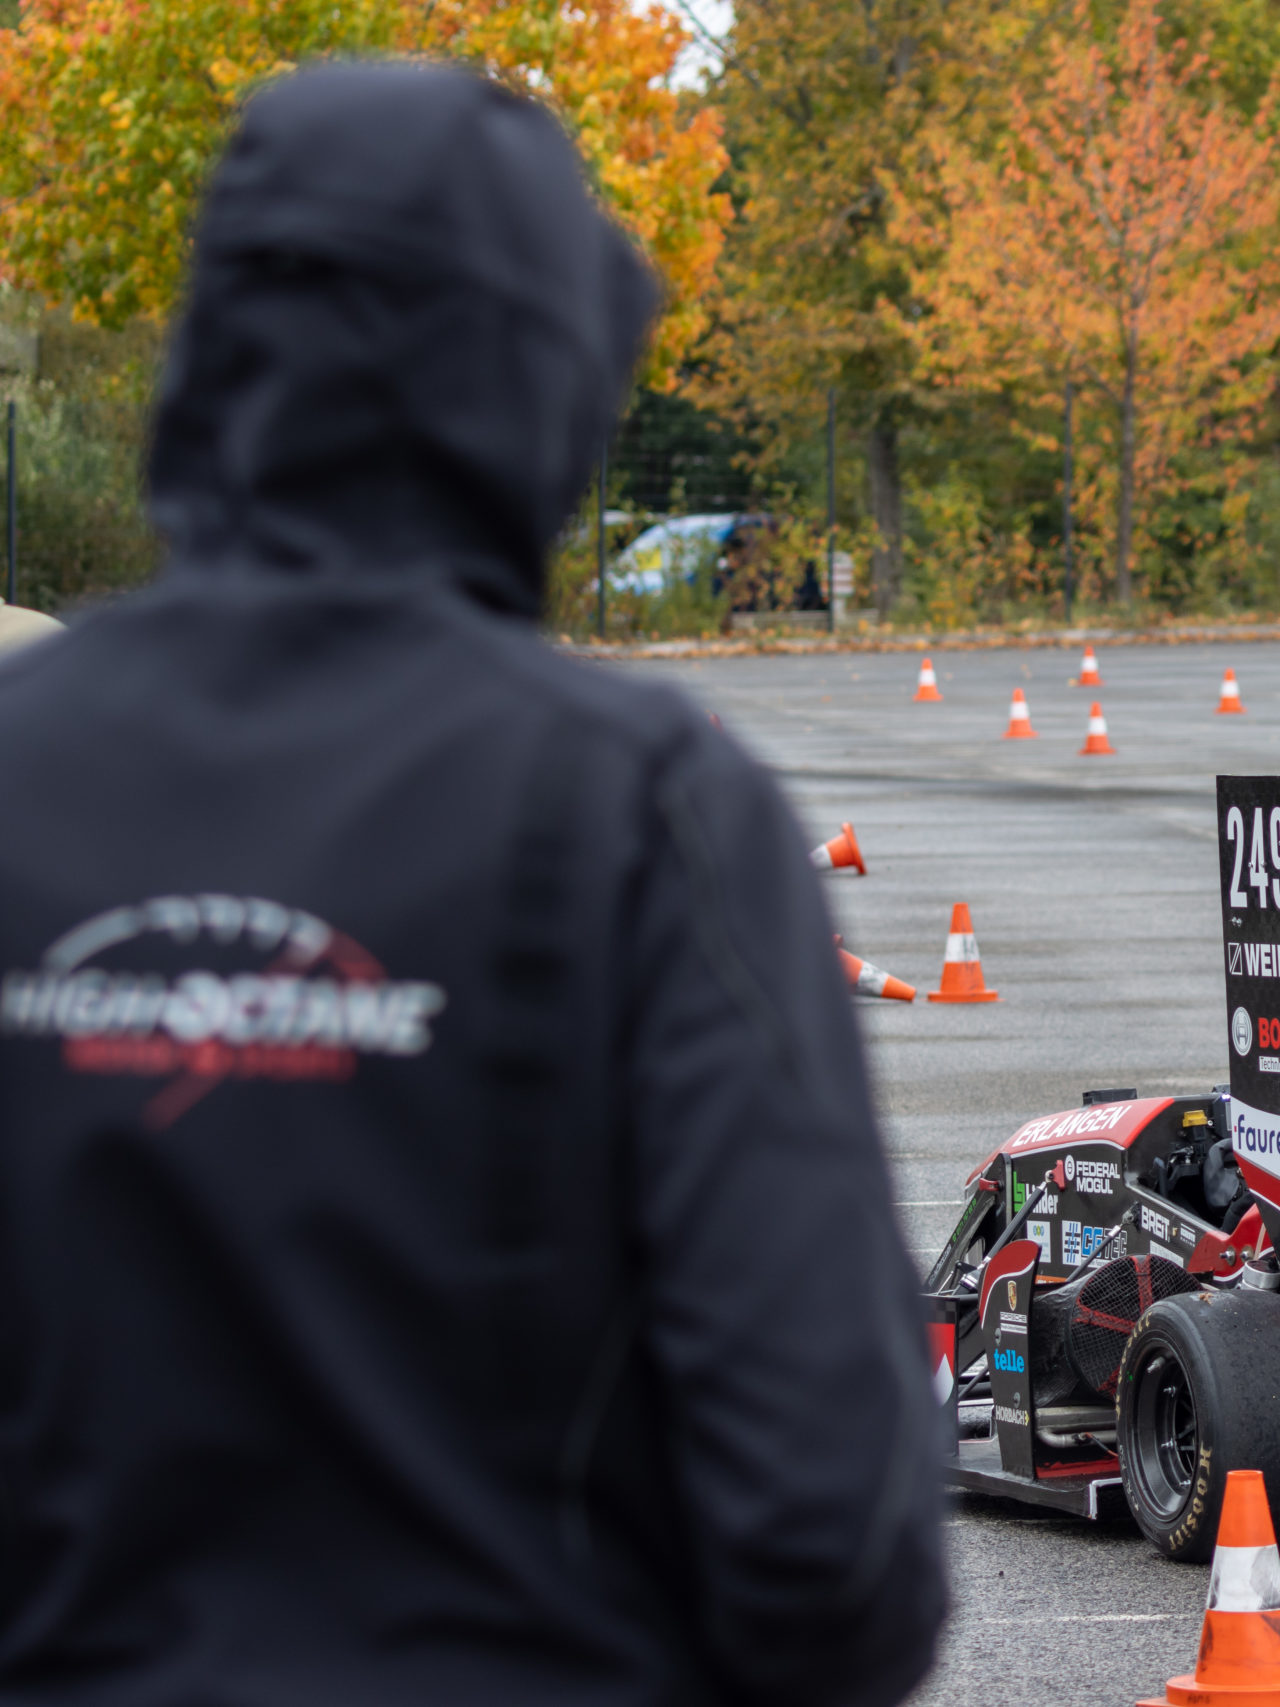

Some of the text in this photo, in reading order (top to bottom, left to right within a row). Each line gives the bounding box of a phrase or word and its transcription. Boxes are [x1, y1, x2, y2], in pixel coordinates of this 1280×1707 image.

[1012, 1105, 1132, 1147] ERLANGEN
[1076, 1161, 1121, 1179] FEDERAL
[1076, 1177, 1113, 1194] MOGUL
[1026, 1183, 1058, 1214] bder
[994, 1349, 1025, 1373] telle
[995, 1406, 1025, 1425] HORBACH
[1169, 1439, 1213, 1550] Hoosier
